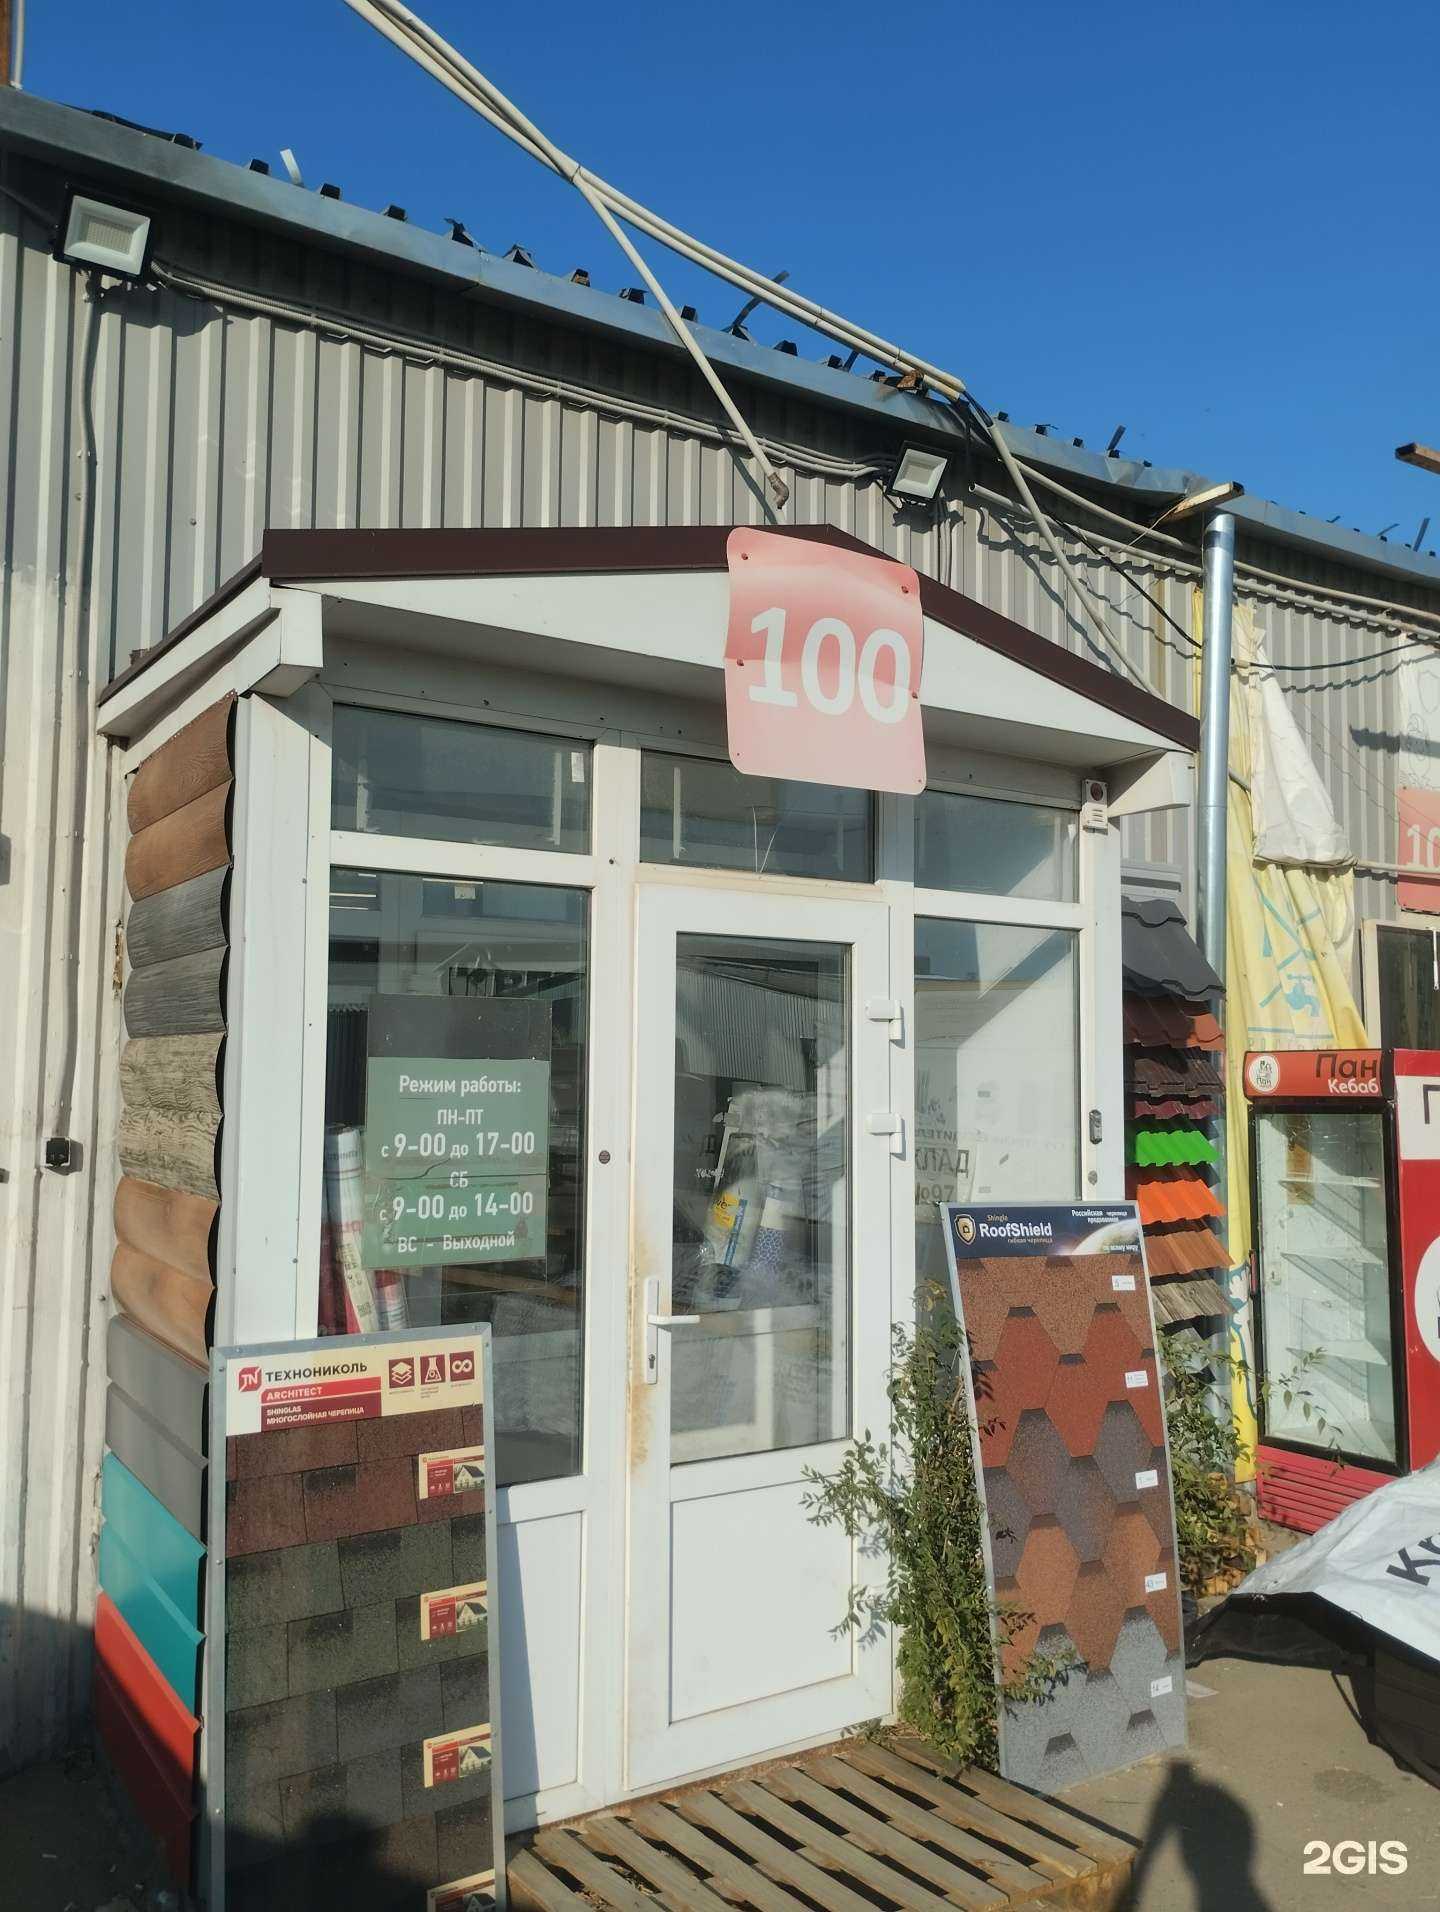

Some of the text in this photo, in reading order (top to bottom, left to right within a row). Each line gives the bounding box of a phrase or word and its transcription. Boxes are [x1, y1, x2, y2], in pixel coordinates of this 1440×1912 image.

[748, 606, 912, 725] 100
[1315, 1053, 1377, 1078] Пан
[399, 1075, 522, 1097] Режим работы:
[1328, 1078, 1379, 1094] Кебаб
[436, 1109, 484, 1125] ПН-ПТ
[381, 1145, 389, 1158] с
[394, 1132, 446, 1157] 9-00
[450, 1143, 469, 1159] до
[475, 1131, 535, 1156] 17-00
[449, 1171, 469, 1188] СБ
[379, 1191, 534, 1221] с 9-00 до 14-00
[1071, 1208, 1103, 1217] Российская
[979, 1222, 1052, 1238] RoofShield
[398, 1236, 417, 1253] ВС
[442, 1230, 515, 1251] Выходной
[265, 1362, 368, 1382] ТЕХНОНИКОЛЬ
[266, 1386, 323, 1401] ARCHITECT
[266, 1405, 302, 1416] SHINGLAS
[266, 1406, 365, 1425] МНОГОСЛОЙНАЯ ЧЕРЕПИЦА
